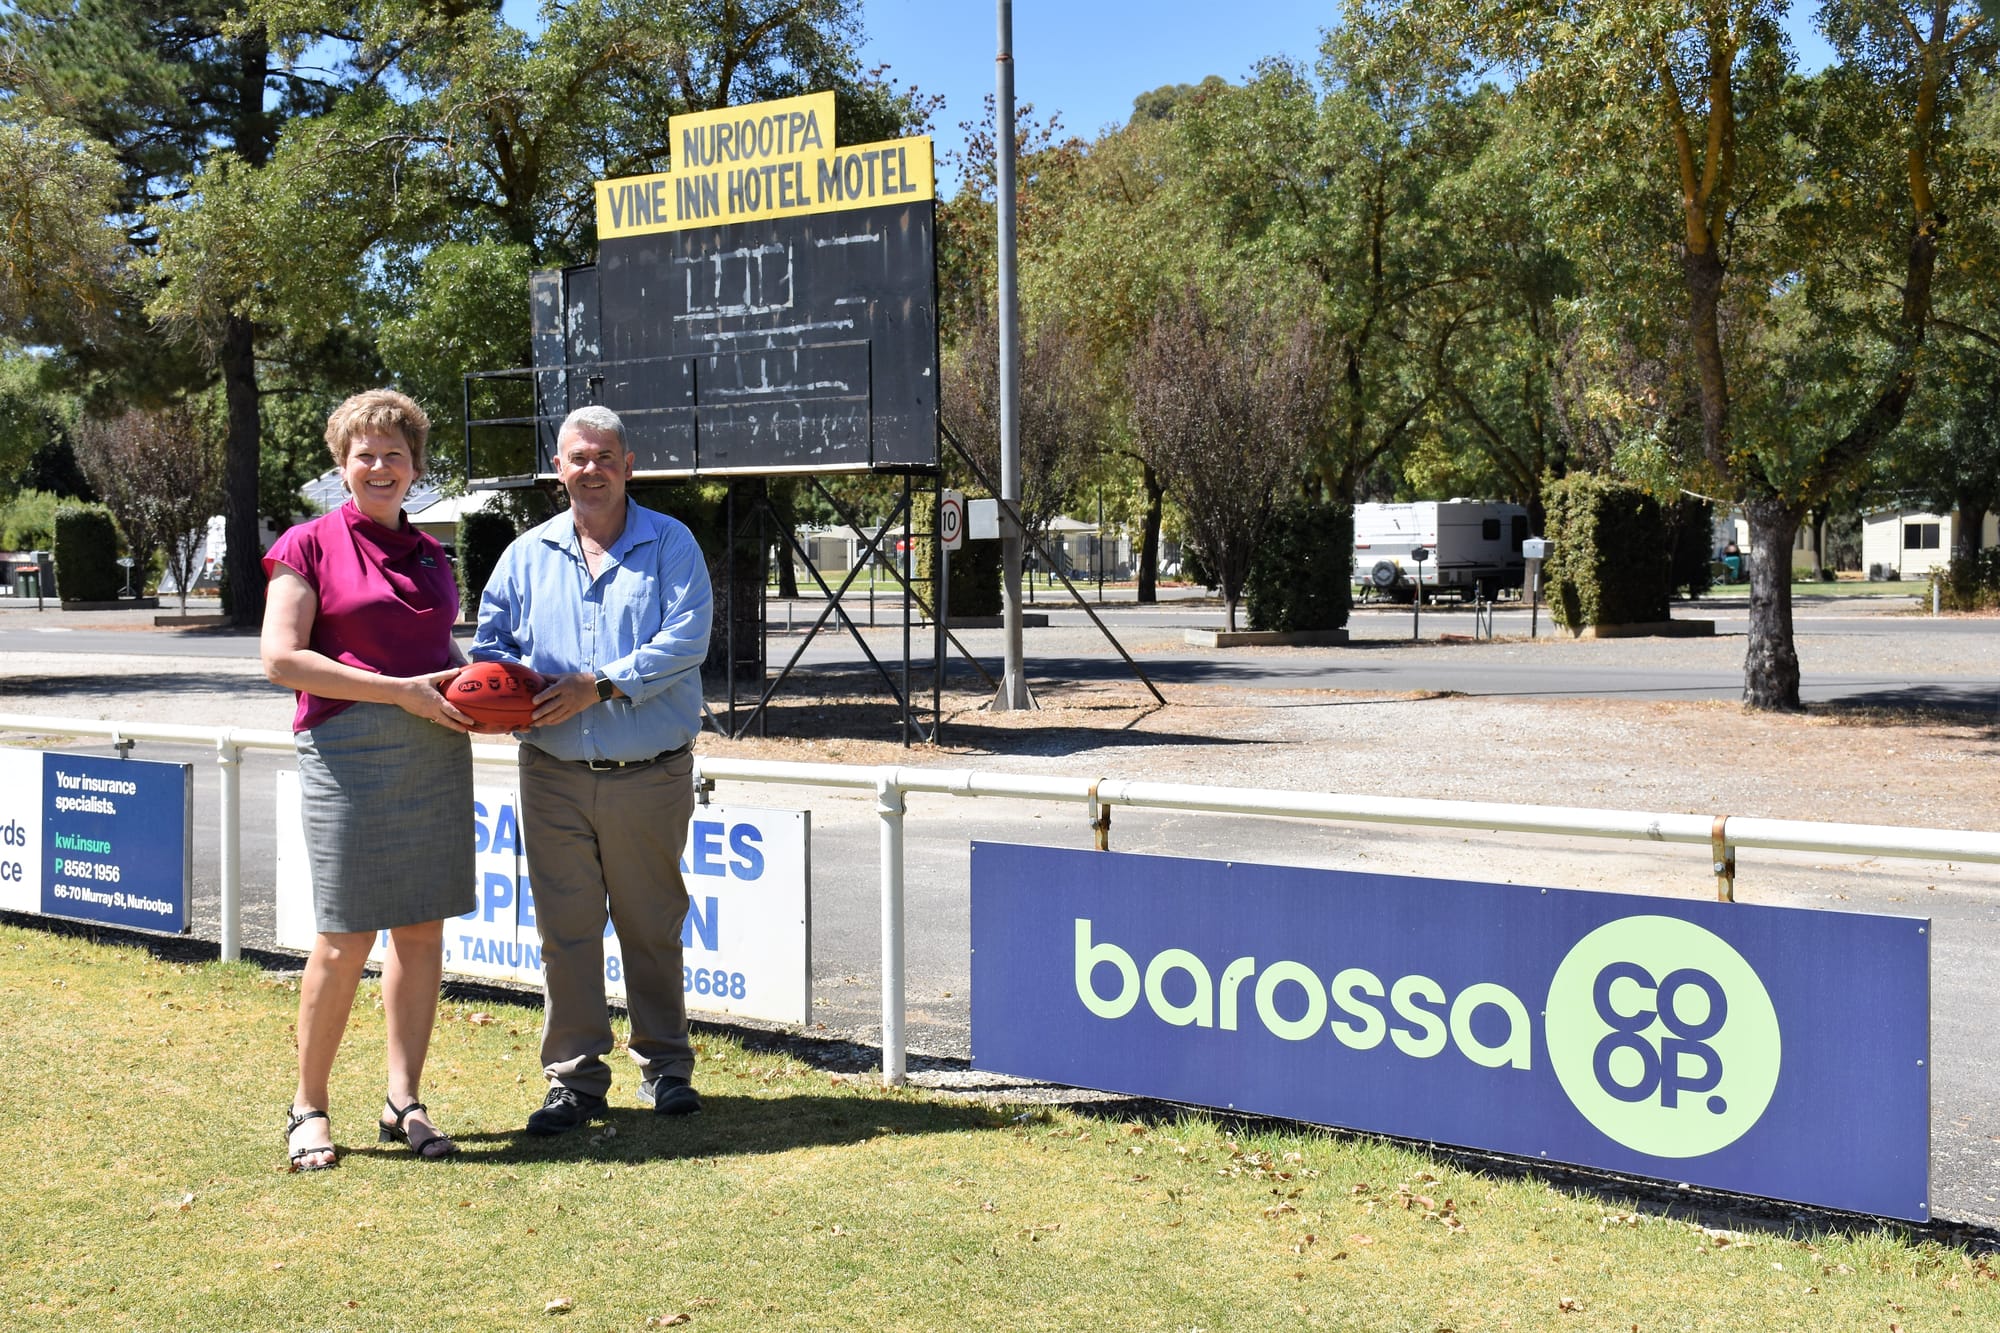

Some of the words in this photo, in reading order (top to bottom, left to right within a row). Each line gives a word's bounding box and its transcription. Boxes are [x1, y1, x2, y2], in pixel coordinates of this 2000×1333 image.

[683, 110, 823, 168] NURIOOTPA
[608, 181, 667, 229] VINE
[676, 173, 720, 221] INN
[728, 160, 811, 214] HOTEL
[817, 147, 917, 204] MOTEL
[942, 511, 956, 532] 10
[56, 771, 82, 789] Your
[82, 774, 136, 795] insurance
[55, 795, 116, 815] specialists.
[55, 832, 111, 854] kwi.insure
[55, 858, 63, 874] P
[64, 860, 92, 879] 8562
[94, 864, 120, 883] 1956
[54, 884, 81, 900] 66-70
[82, 887, 114, 907] Murray
[114, 892, 127, 909] St,
[127, 894, 173, 915] Nuriootpa
[1075, 918, 1531, 1070] barossa
